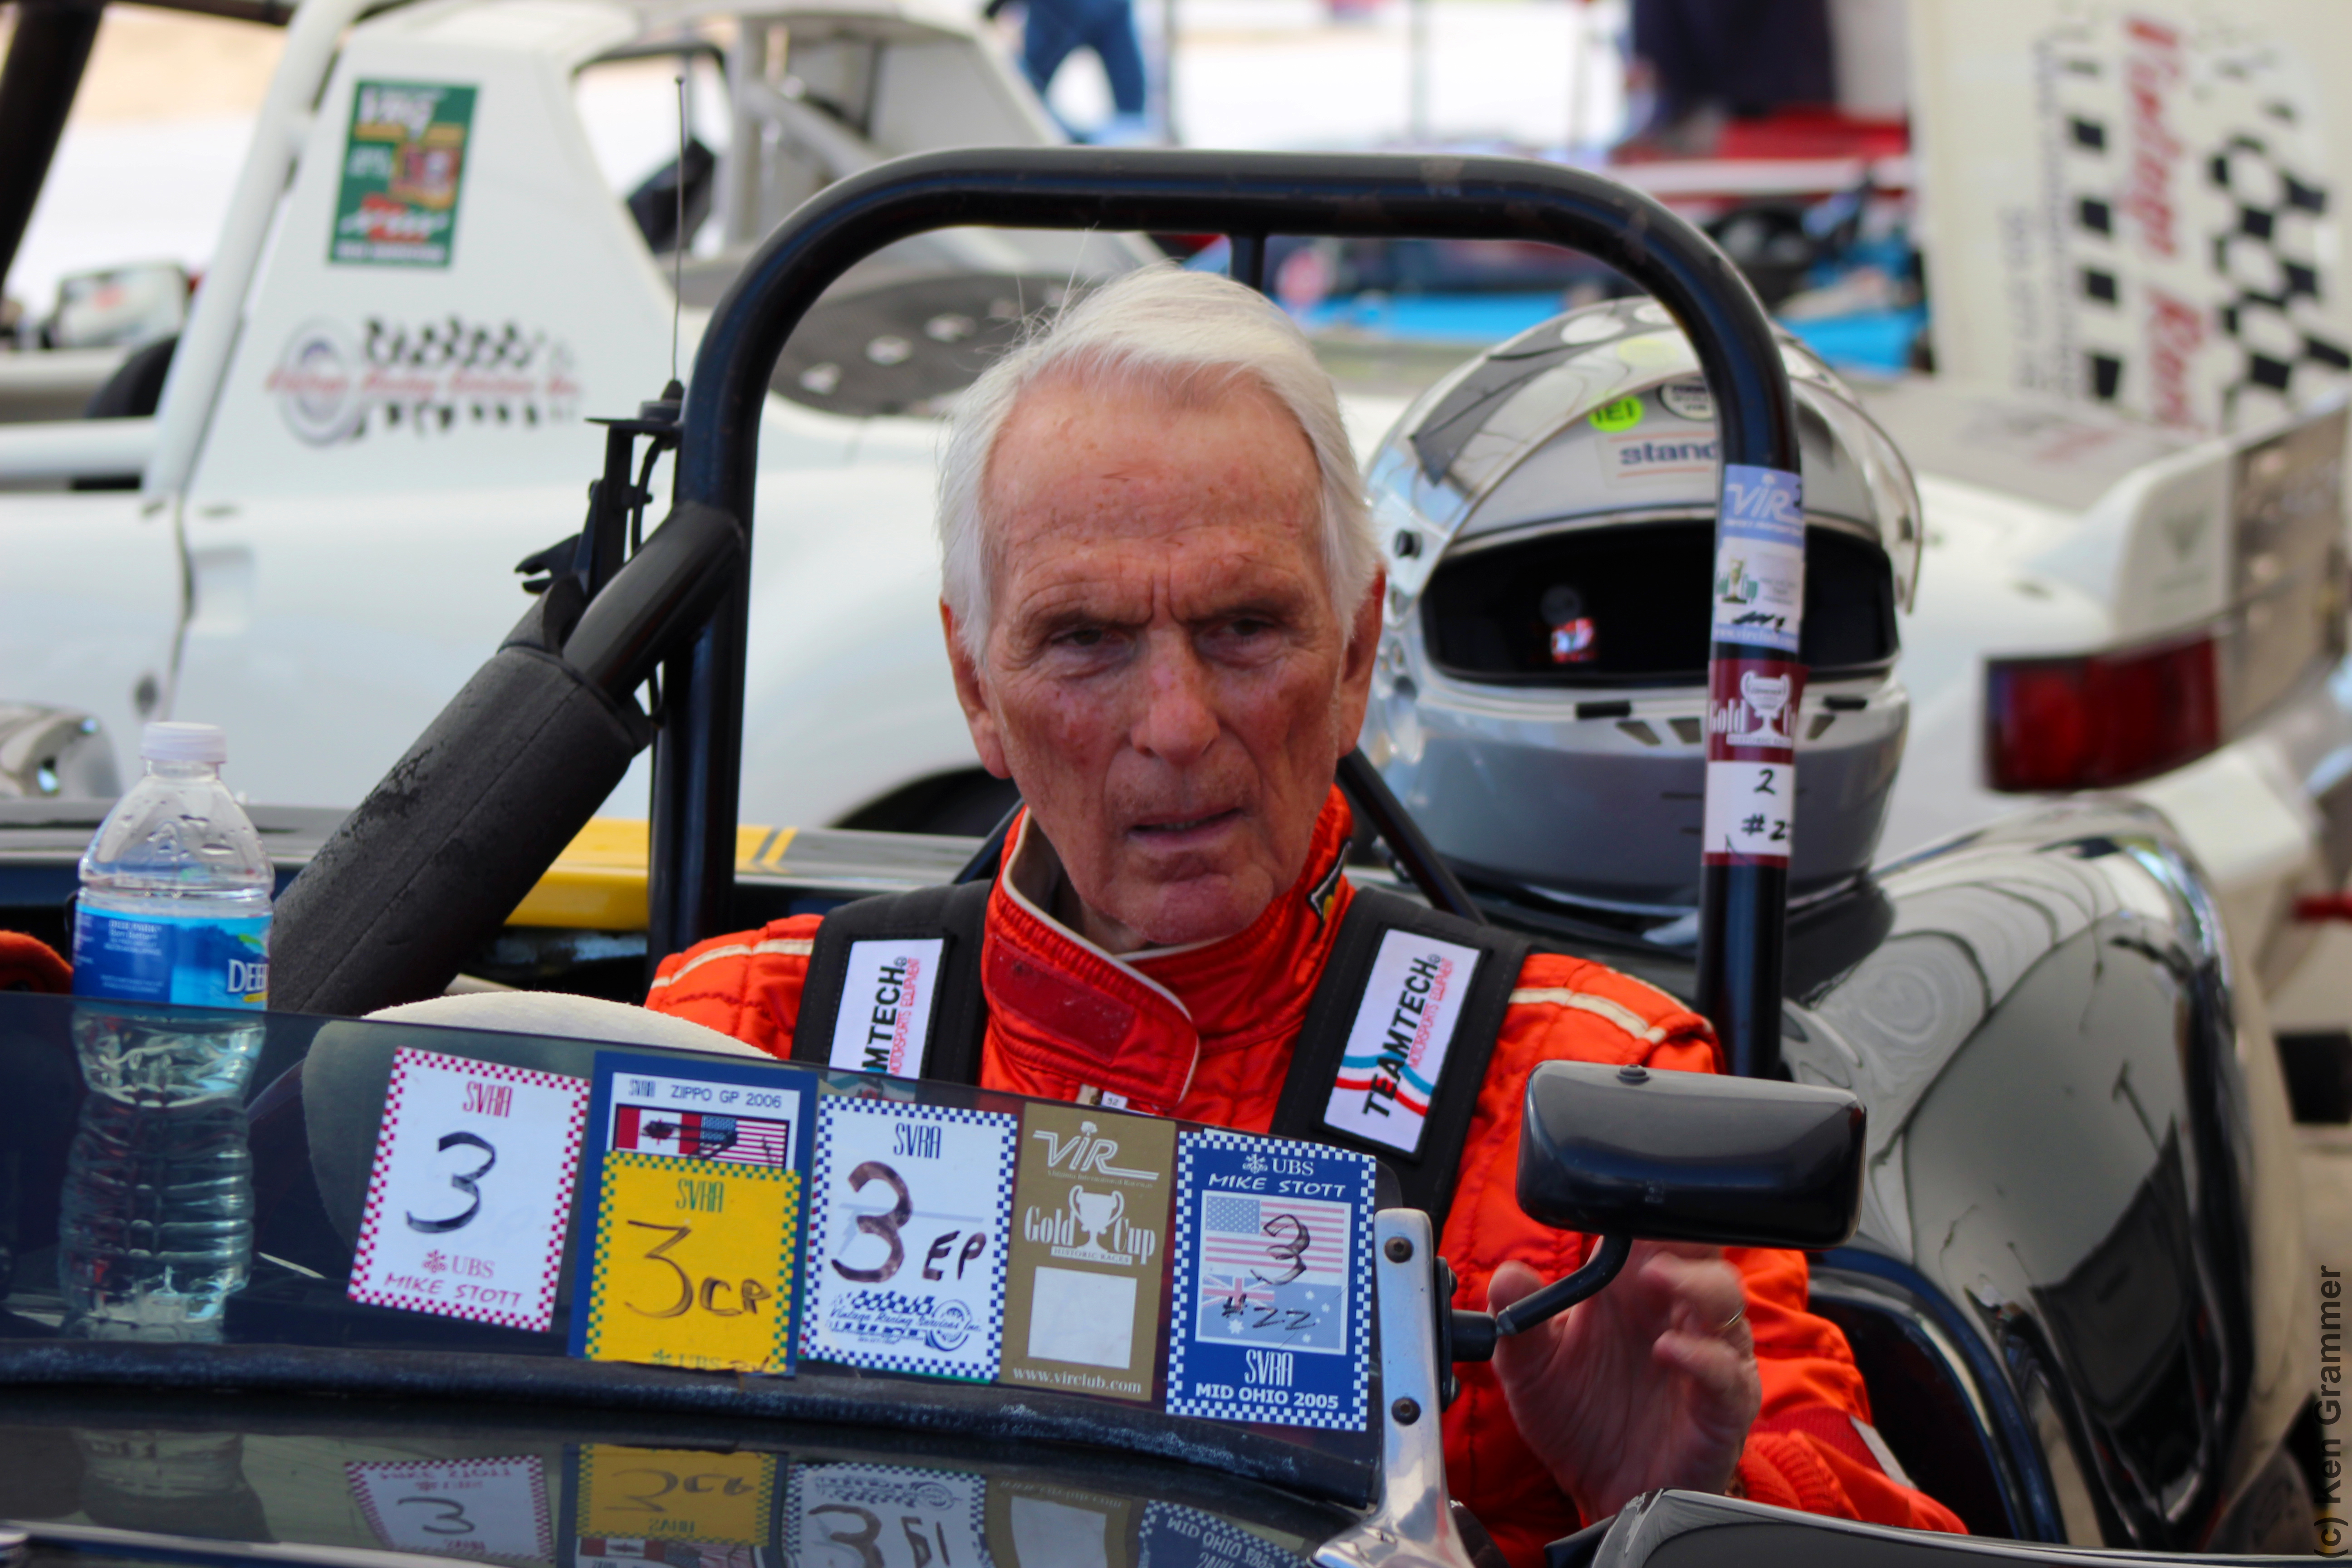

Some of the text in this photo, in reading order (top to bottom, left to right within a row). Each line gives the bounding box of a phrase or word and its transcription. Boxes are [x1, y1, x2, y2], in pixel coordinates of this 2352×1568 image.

[1754, 768, 1776, 795] 2
[670, 1084, 713, 1102] ZIPPO
[719, 1090, 740, 1104] GP
[745, 1093, 782, 1109] 2006
[893, 1122, 942, 1159] SVRA
[405, 1131, 496, 1234] 3
[1271, 1158, 1315, 1176] UBS
[1208, 1173, 1346, 1198] MIKE STOTT
[830, 1161, 987, 1283] 3 EP
[1024, 1205, 1156, 1265] Gold Cup
[453, 1254, 495, 1279] UBS
[1250, 1214, 1311, 1286] 3
[624, 1220, 693, 1318] 3
[383, 1272, 524, 1308] MIKE STOTT
[1013, 1367, 1142, 1394] www.virclub.com
[1244, 1348, 1294, 1387] SVRA
[1196, 1382, 1339, 1409] MID OHIO 2005
